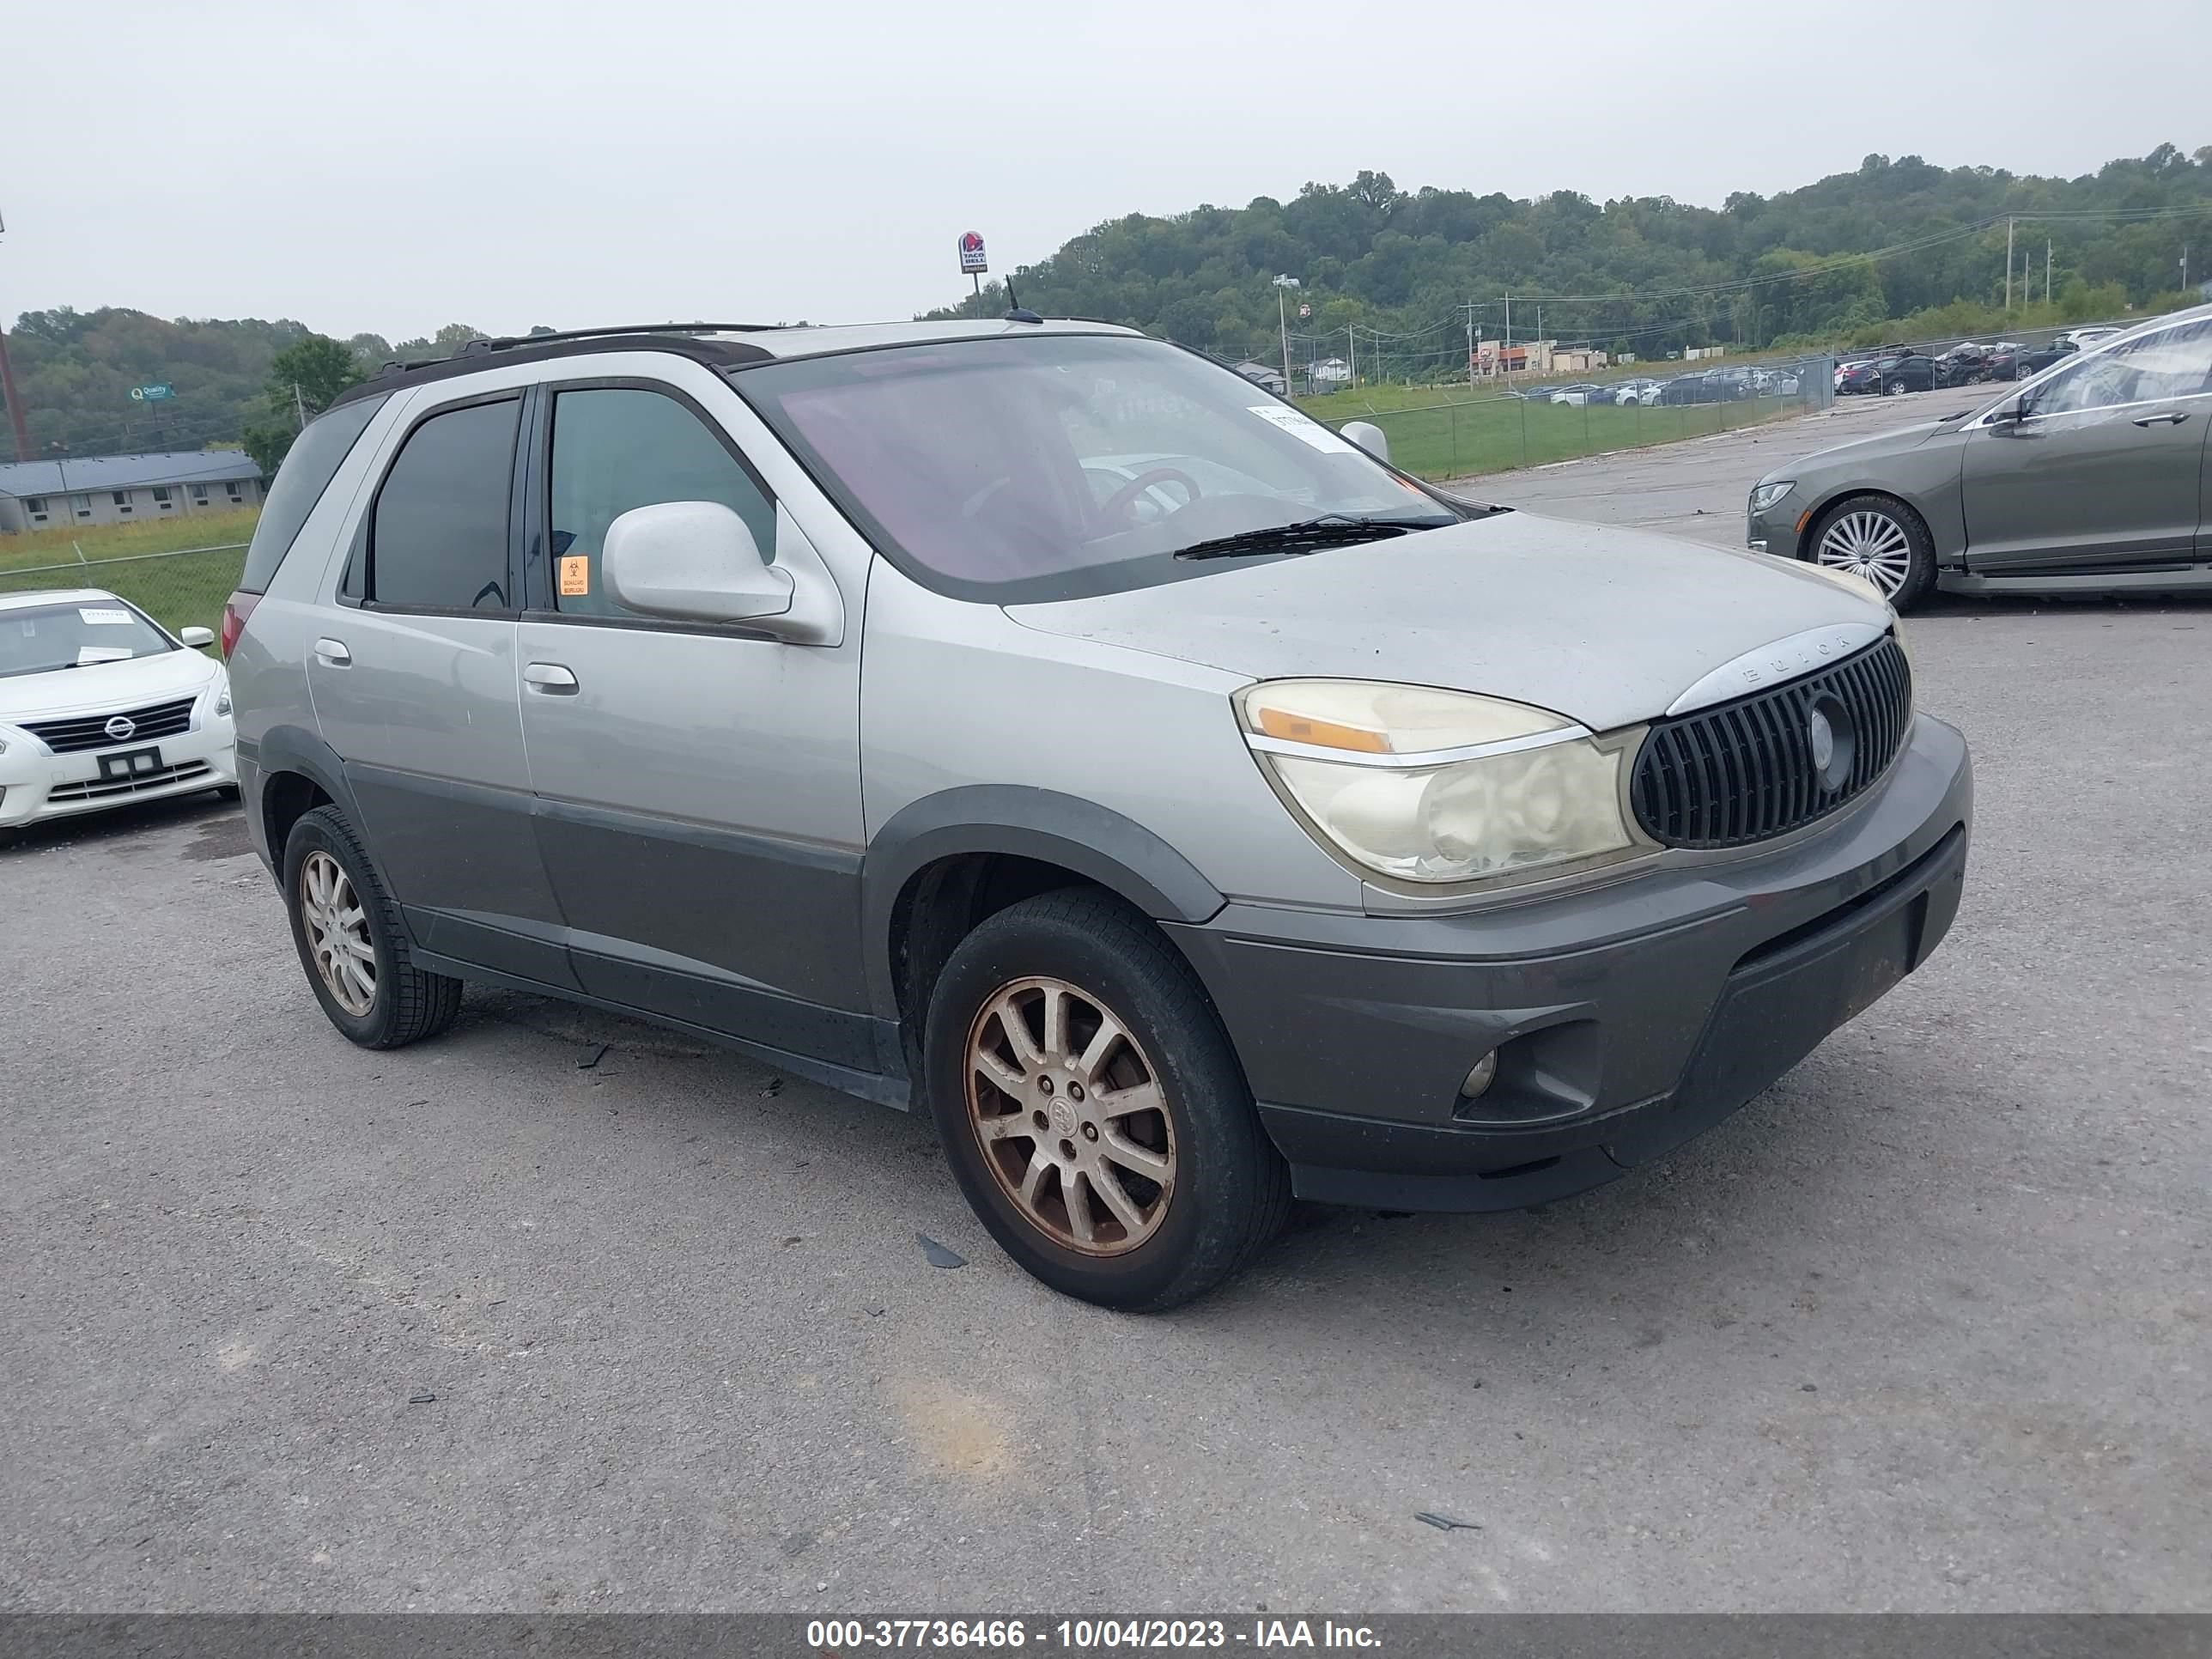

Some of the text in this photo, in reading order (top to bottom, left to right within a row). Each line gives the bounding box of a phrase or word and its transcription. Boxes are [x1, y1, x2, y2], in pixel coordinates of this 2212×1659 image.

[143, 386, 166, 394] Quality
[1742, 635, 1850, 684] BUICK
[108, 724, 134, 732] NISSAN
